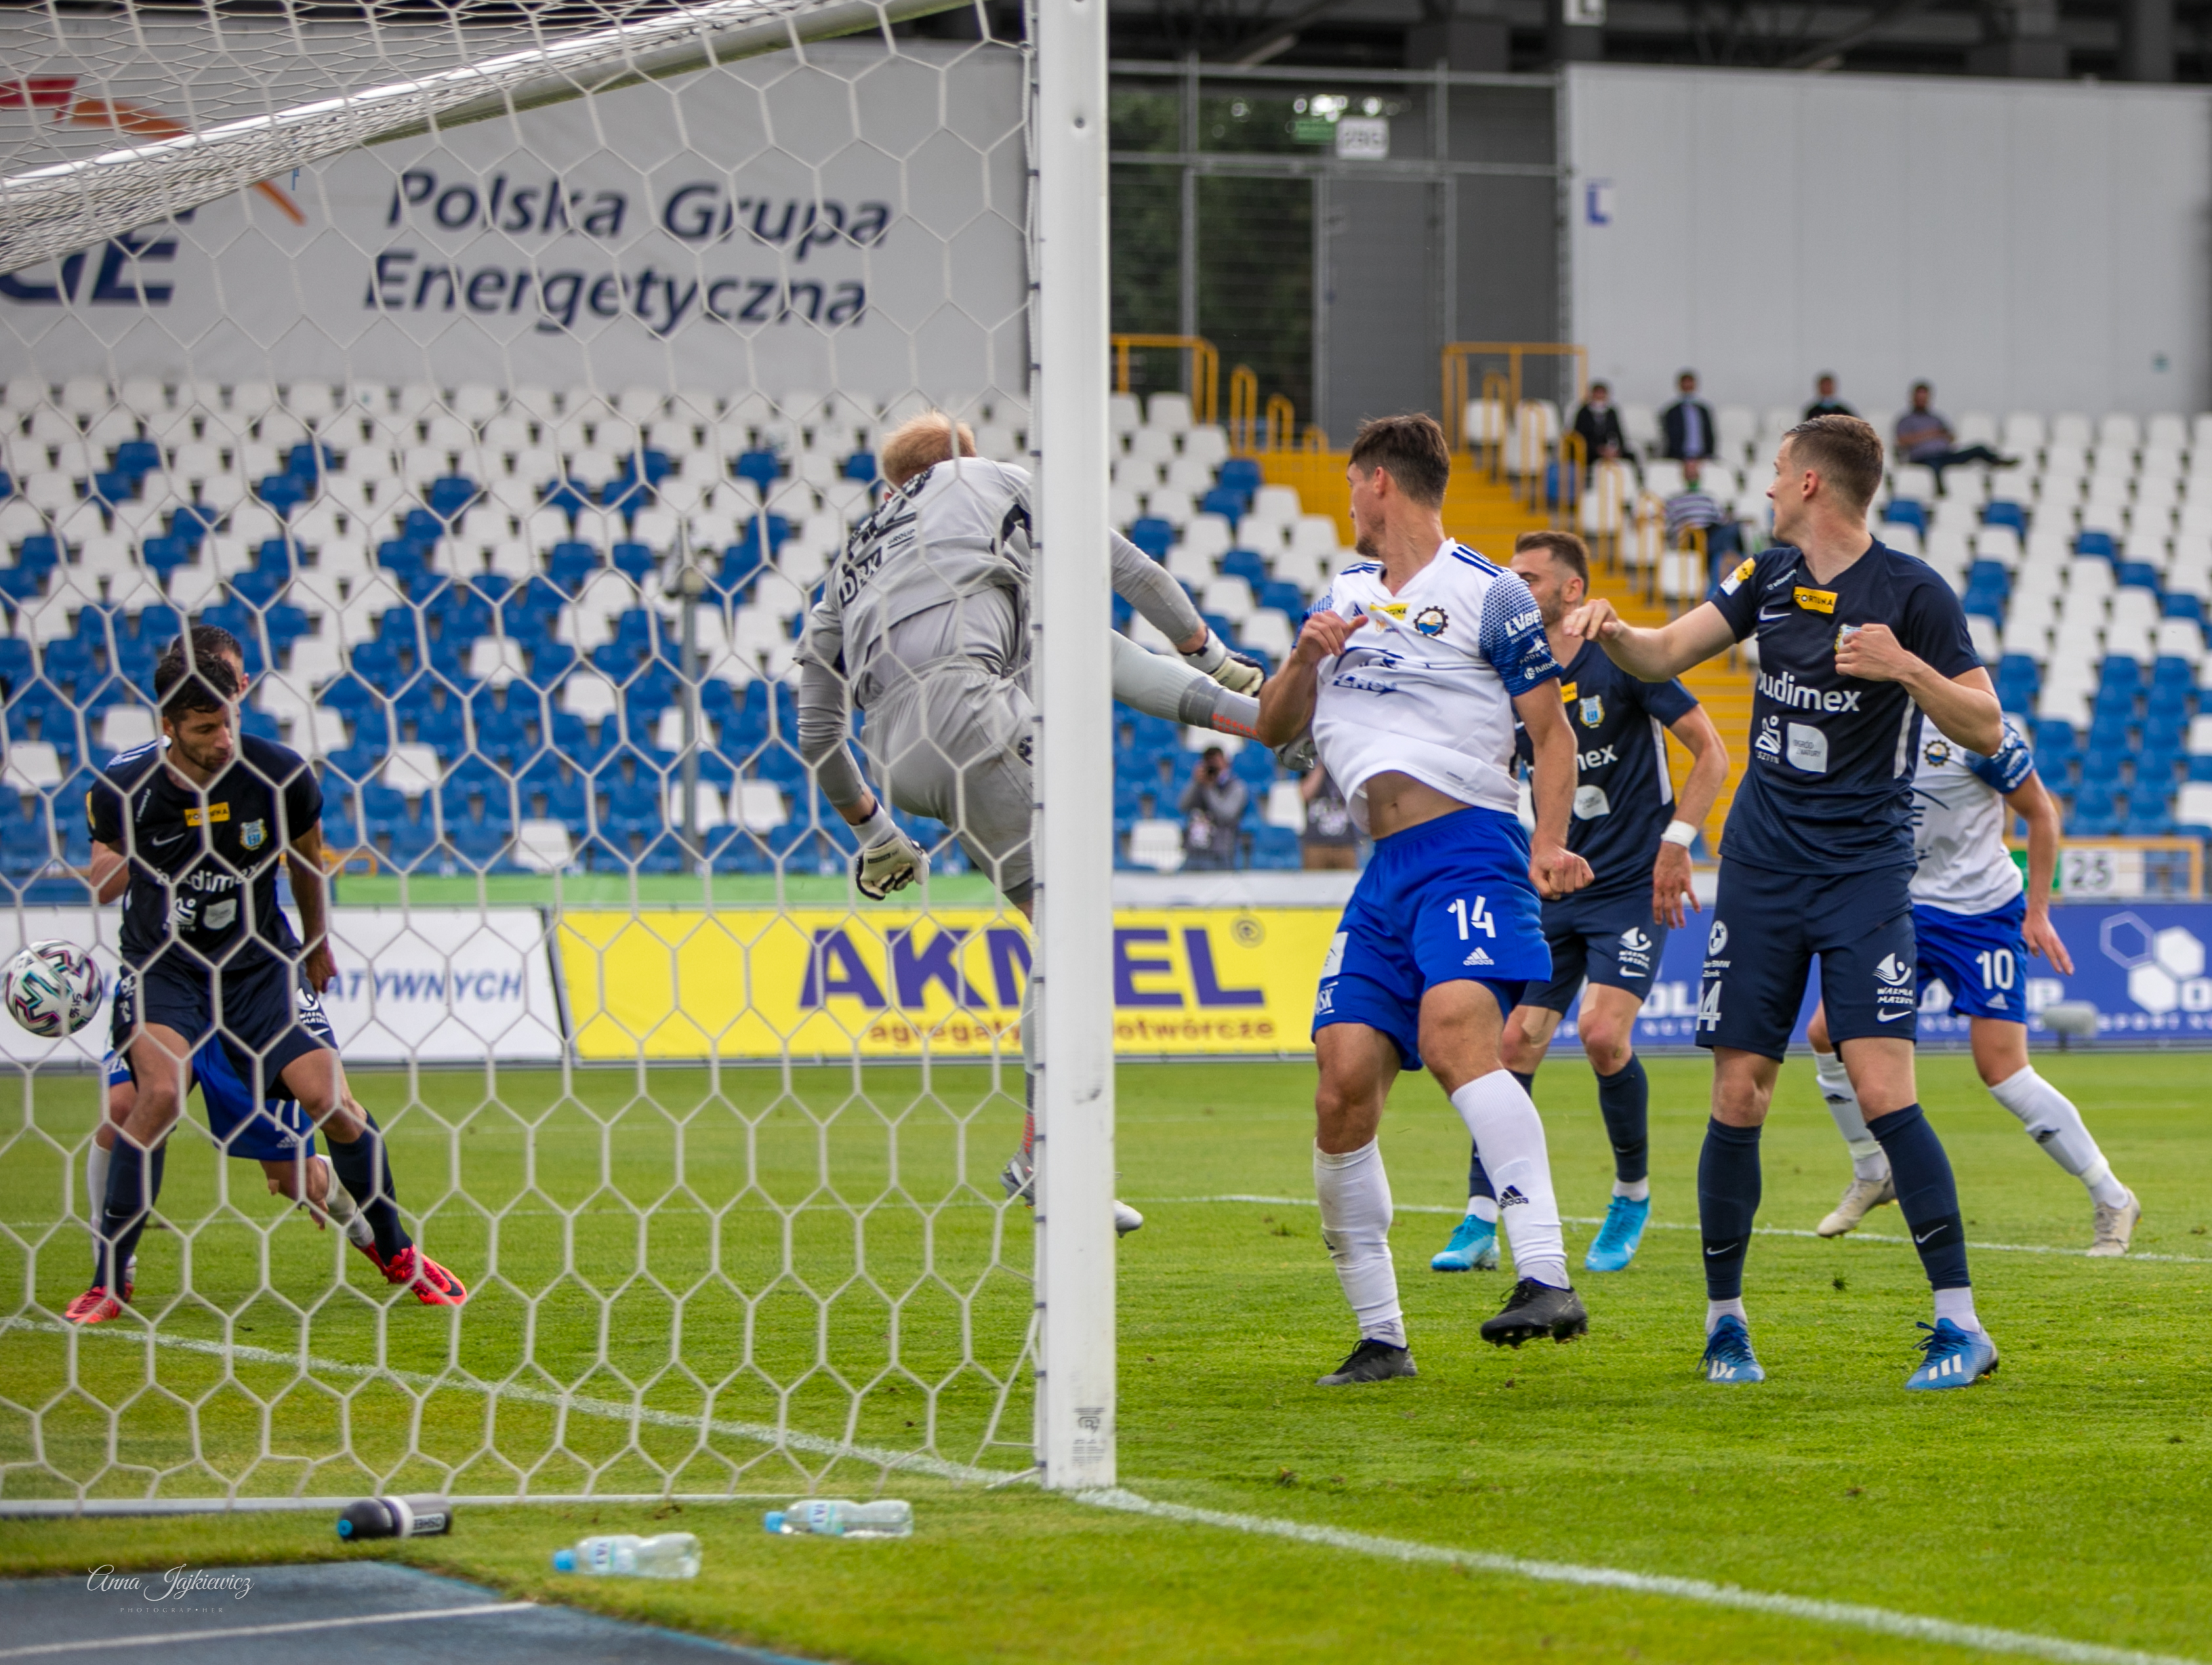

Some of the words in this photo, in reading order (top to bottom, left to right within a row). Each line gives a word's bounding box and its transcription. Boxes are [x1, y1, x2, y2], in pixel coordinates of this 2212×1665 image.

[386, 169, 629, 237] Polska
[661, 181, 893, 263] Grupa
[363, 249, 870, 339] Energetyczna
[1446, 895, 1497, 941] 14
[1975, 949, 2015, 990] 10
